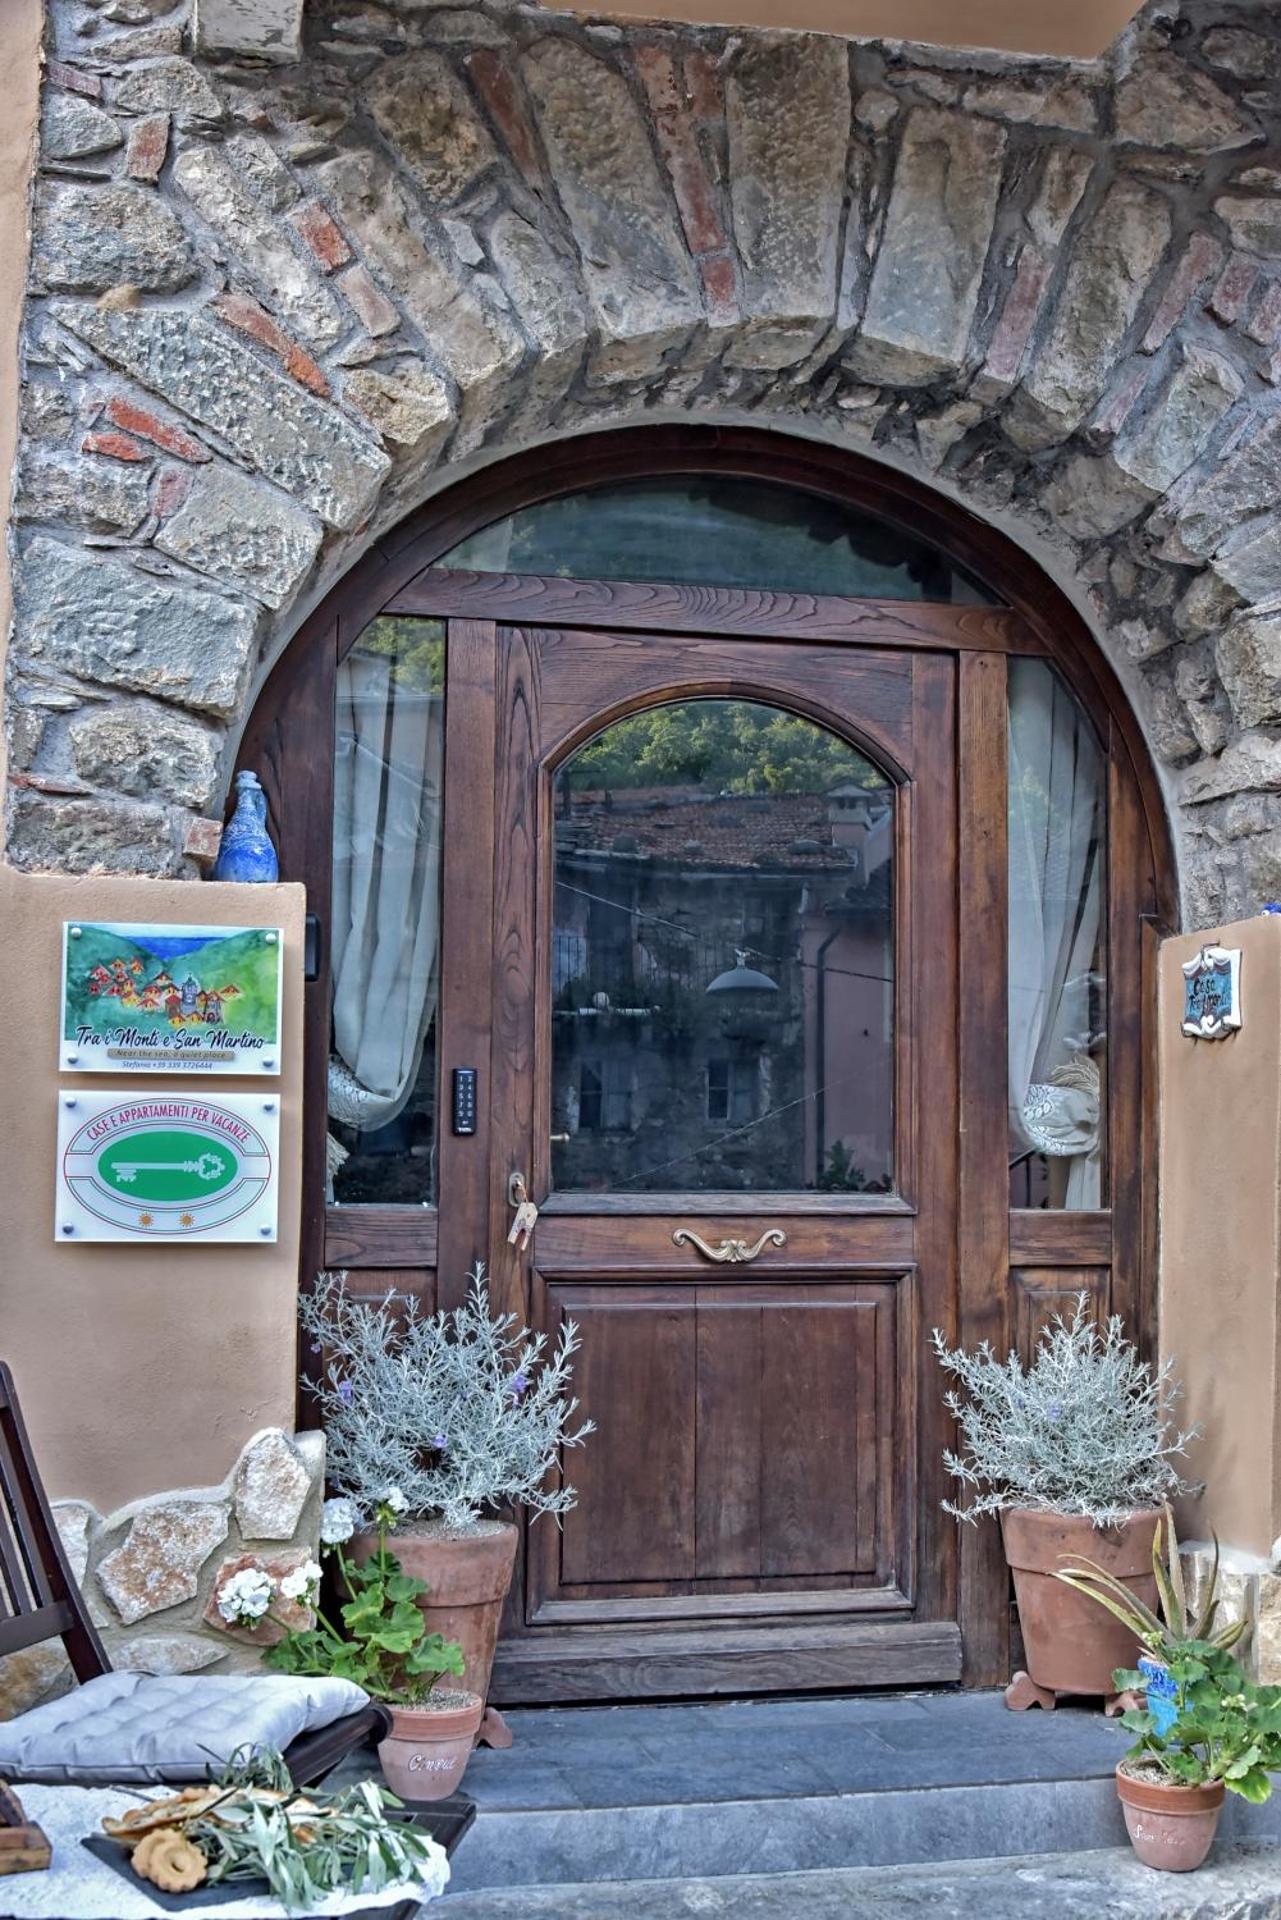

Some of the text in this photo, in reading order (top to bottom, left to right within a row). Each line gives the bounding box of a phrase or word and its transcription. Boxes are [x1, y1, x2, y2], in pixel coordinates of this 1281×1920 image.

[76, 1026, 264, 1049] Tra i Monti e San Martino
[86, 1104, 251, 1143] CASE E APPARTAMENTI PER VACANZE
